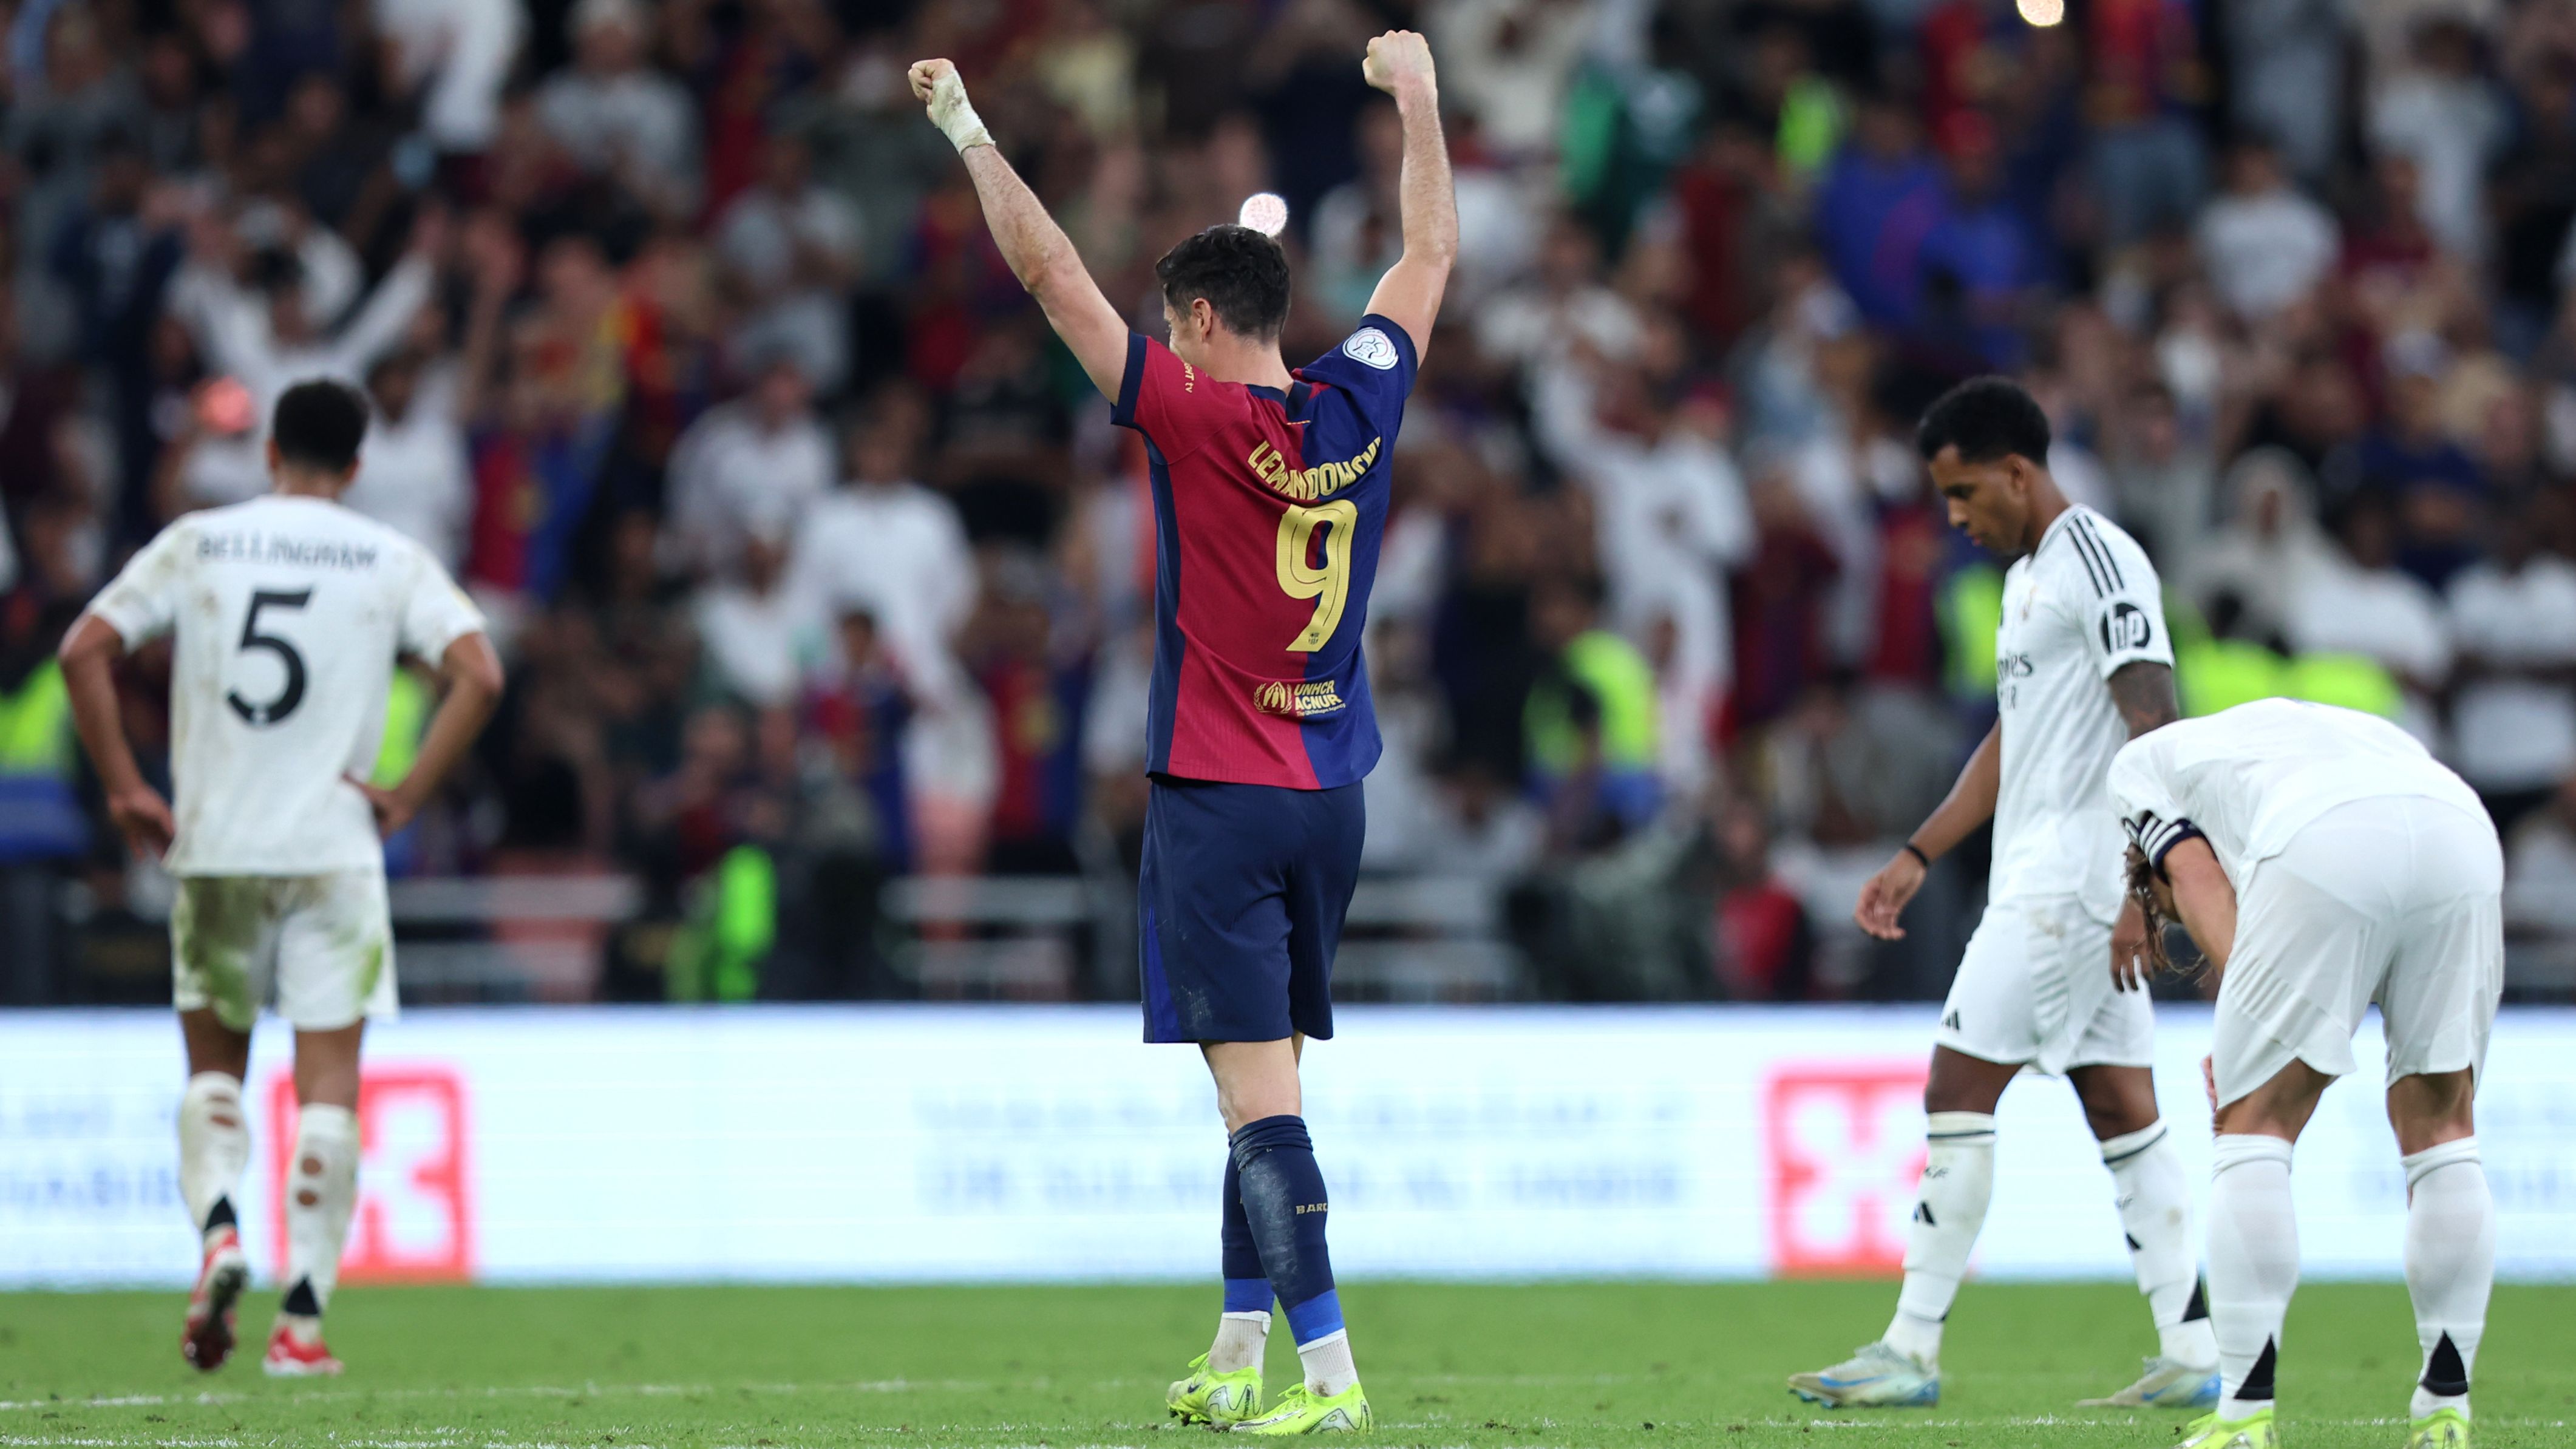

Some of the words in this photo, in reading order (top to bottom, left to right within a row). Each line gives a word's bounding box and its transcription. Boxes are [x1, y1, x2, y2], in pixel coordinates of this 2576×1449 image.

[1277, 500, 1358, 652] 9
[225, 584, 314, 727] 5
[1294, 680, 1334, 695] UNHCR
[1294, 694, 1343, 710] ACNUR
